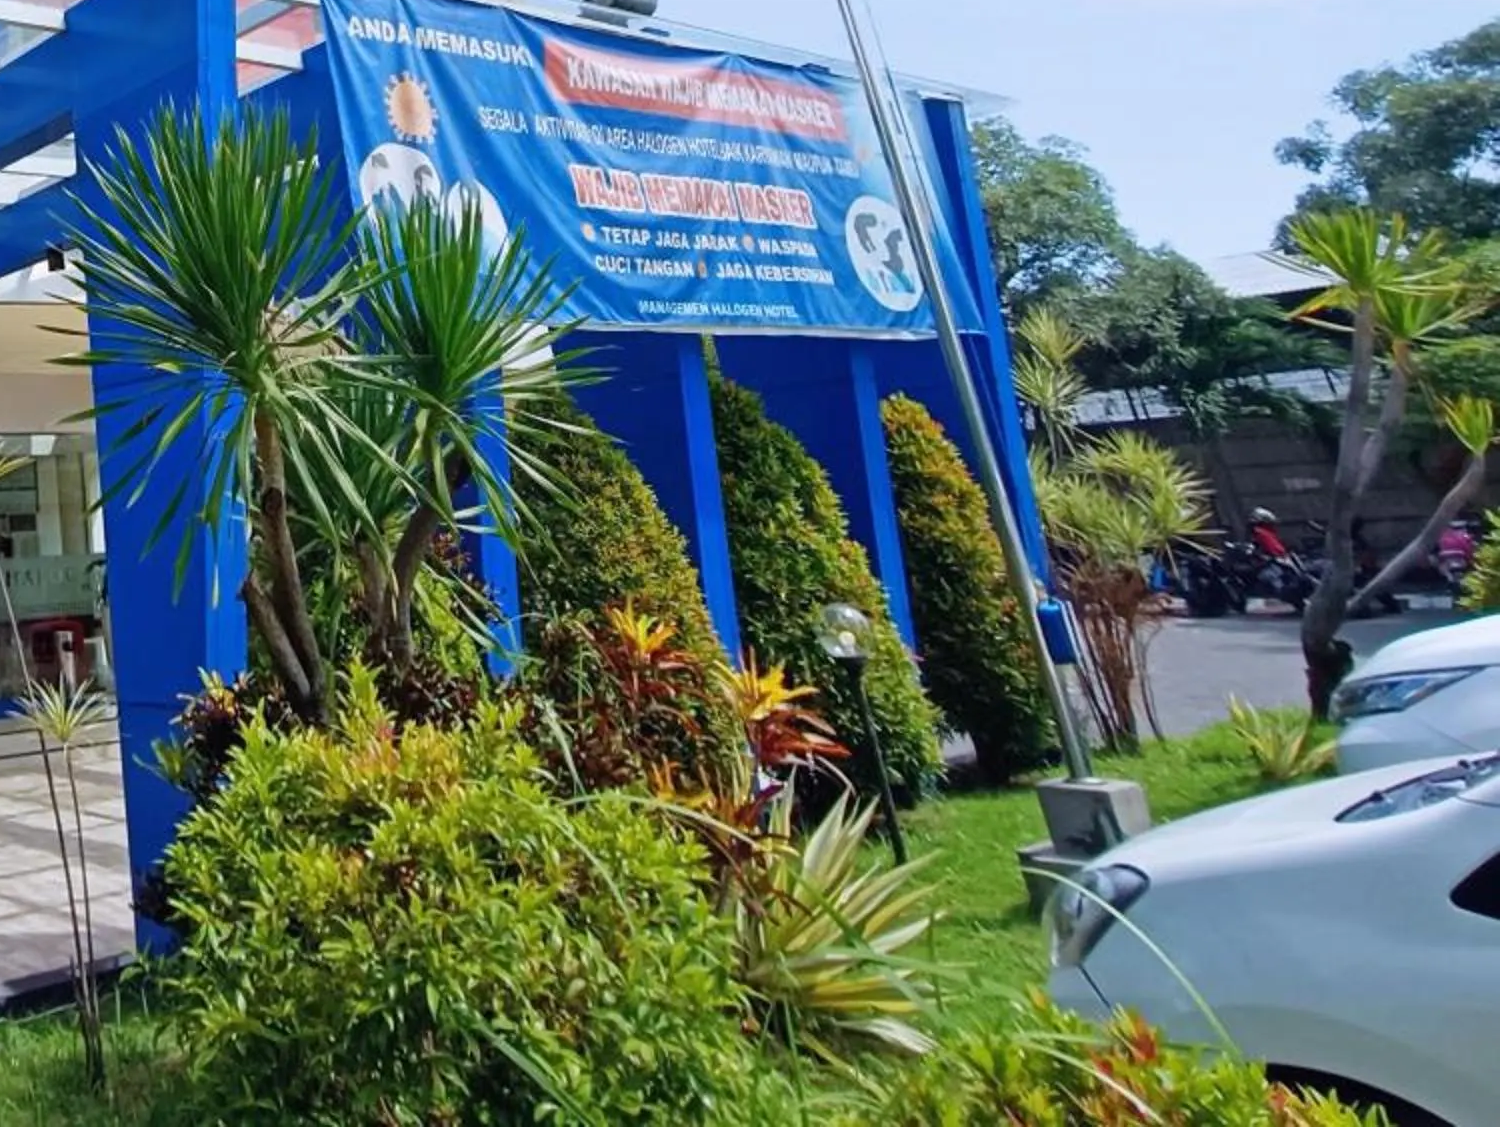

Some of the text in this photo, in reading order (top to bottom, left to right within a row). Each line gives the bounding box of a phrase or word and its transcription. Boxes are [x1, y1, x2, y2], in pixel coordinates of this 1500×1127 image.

[349, 15, 534, 67] ANDA MEMASUKI
[567, 57, 657, 98] KAWASAN
[774, 93, 835, 129] MASKER
[478, 106, 528, 134] SEGALA
[608, 126, 636, 150] AREA
[638, 129, 690, 158] HALOGEN
[569, 163, 817, 229] WAJIB MEMAKAI MASKER
[600, 226, 650, 246] TETAP
[655, 231, 689, 249] JAGA
[694, 233, 738, 250] JARAK
[595, 255, 631, 274] CUCI
[635, 257, 694, 276] TANGAN
[716, 262, 753, 279] JAGA
[712, 302, 762, 316] HALOGEN
[762, 304, 798, 318] HOTEL
